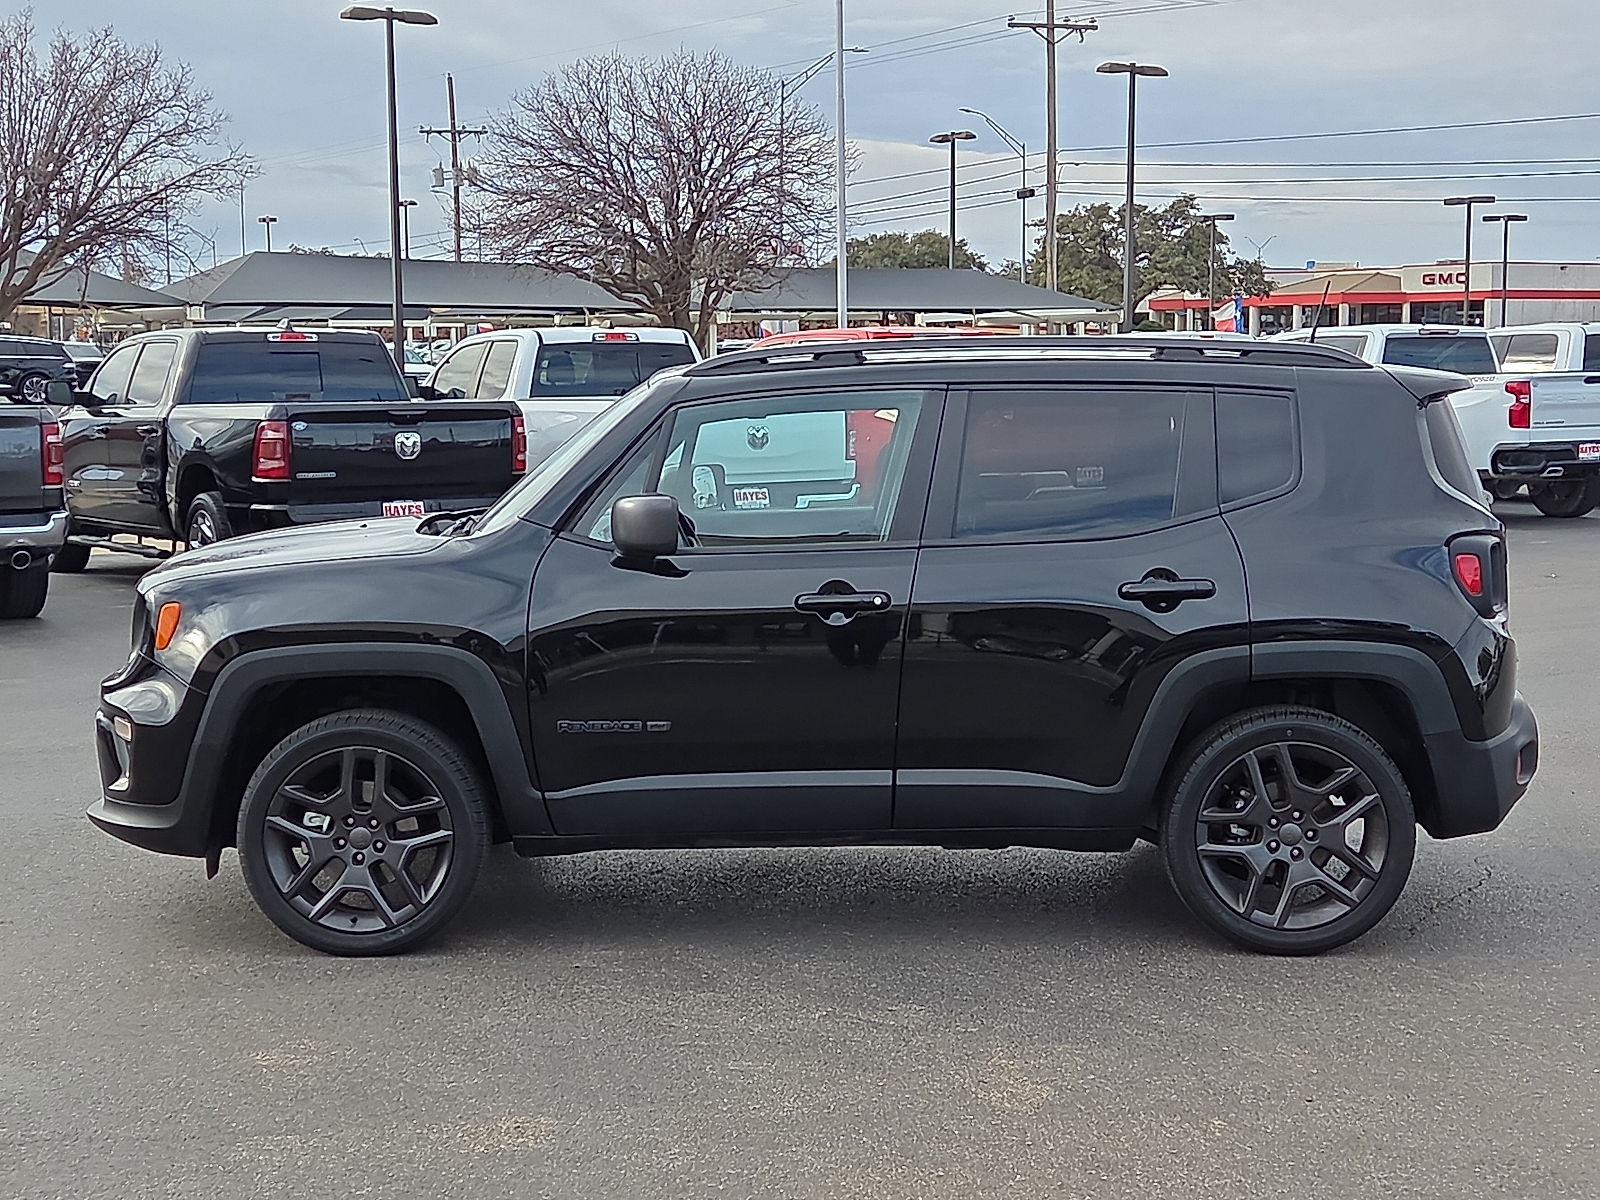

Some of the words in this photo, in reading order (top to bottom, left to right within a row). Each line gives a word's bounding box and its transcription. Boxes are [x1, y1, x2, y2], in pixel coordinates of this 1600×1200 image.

[1423, 272, 1468, 285] GMC
[735, 491, 768, 502] HAYES
[384, 504, 423, 517] HAYES
[557, 720, 643, 733] RENEGADE
